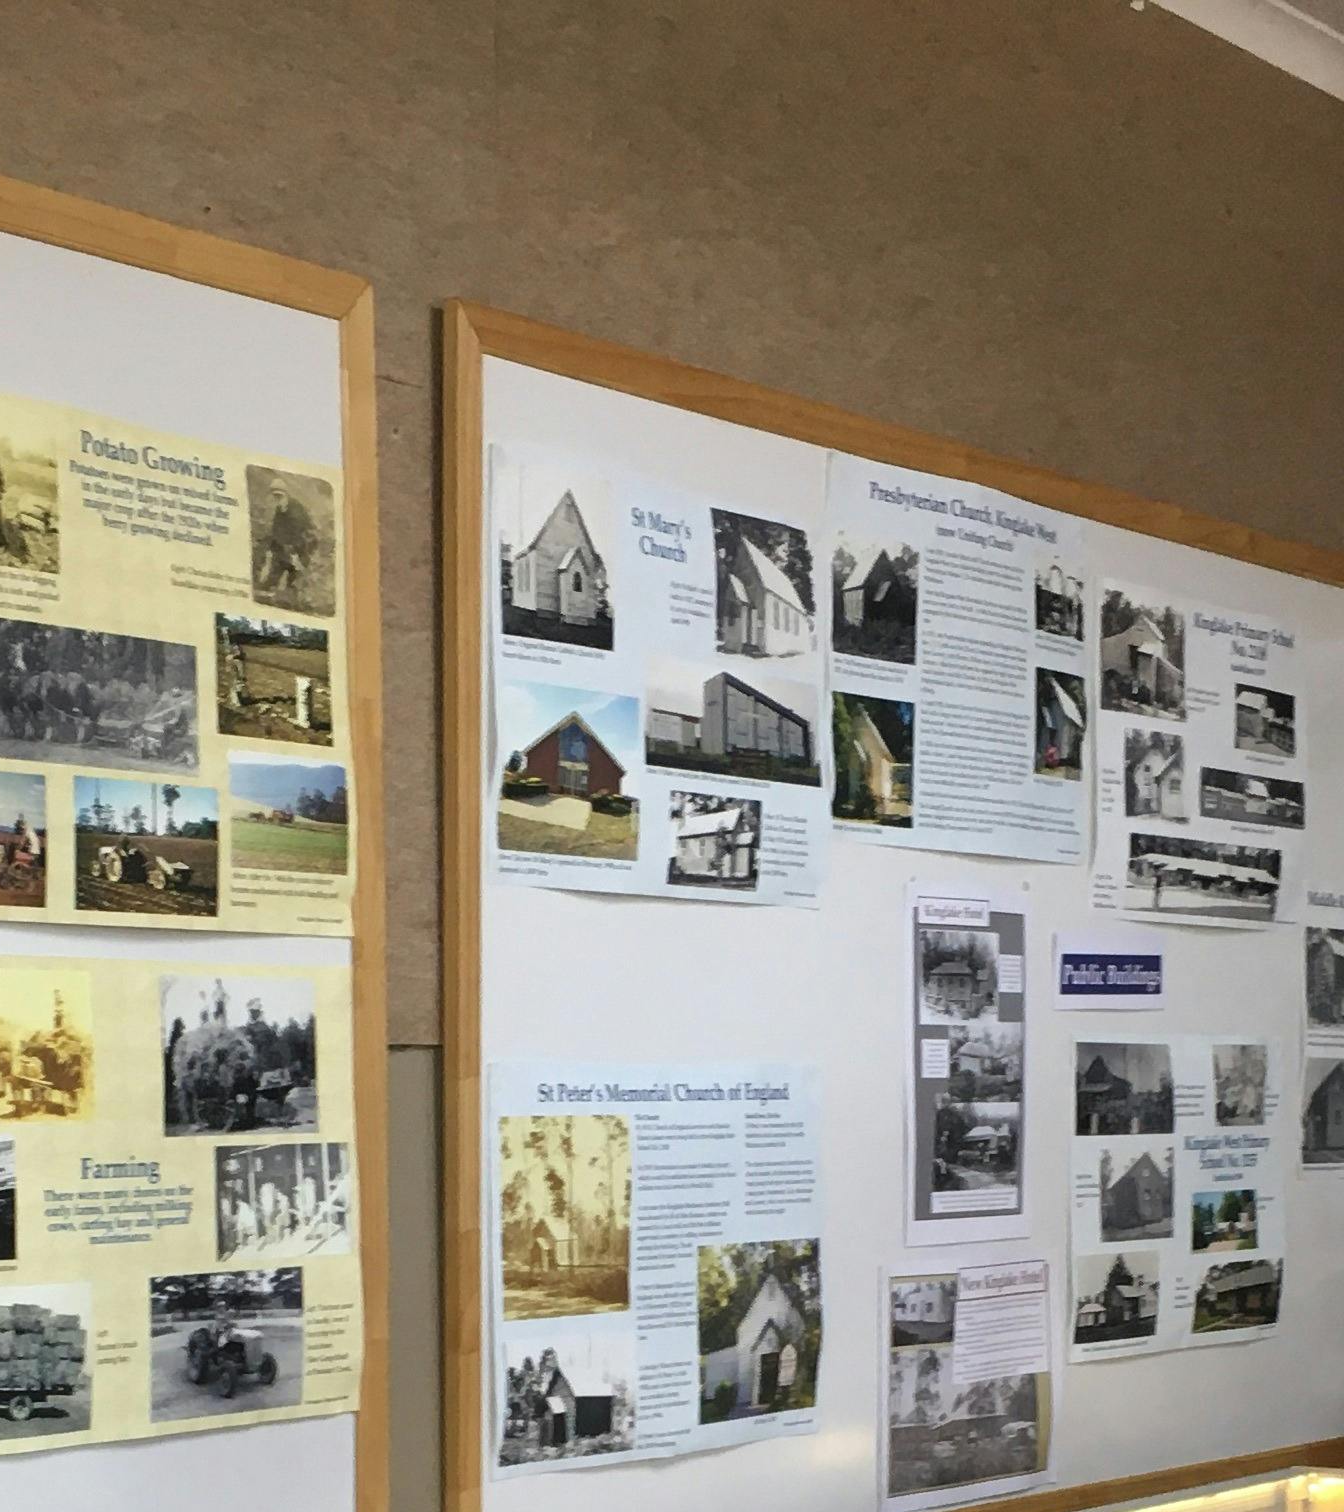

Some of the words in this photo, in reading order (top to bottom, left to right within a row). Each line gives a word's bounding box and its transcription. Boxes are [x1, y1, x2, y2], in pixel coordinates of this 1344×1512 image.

[80, 429, 138, 465] Potato
[142, 445, 226, 491] Growing
[648, 511, 692, 542] Mary's
[639, 535, 687, 563] Church
[537, 1083, 554, 1102] St
[80, 1155, 161, 1184] Farming
